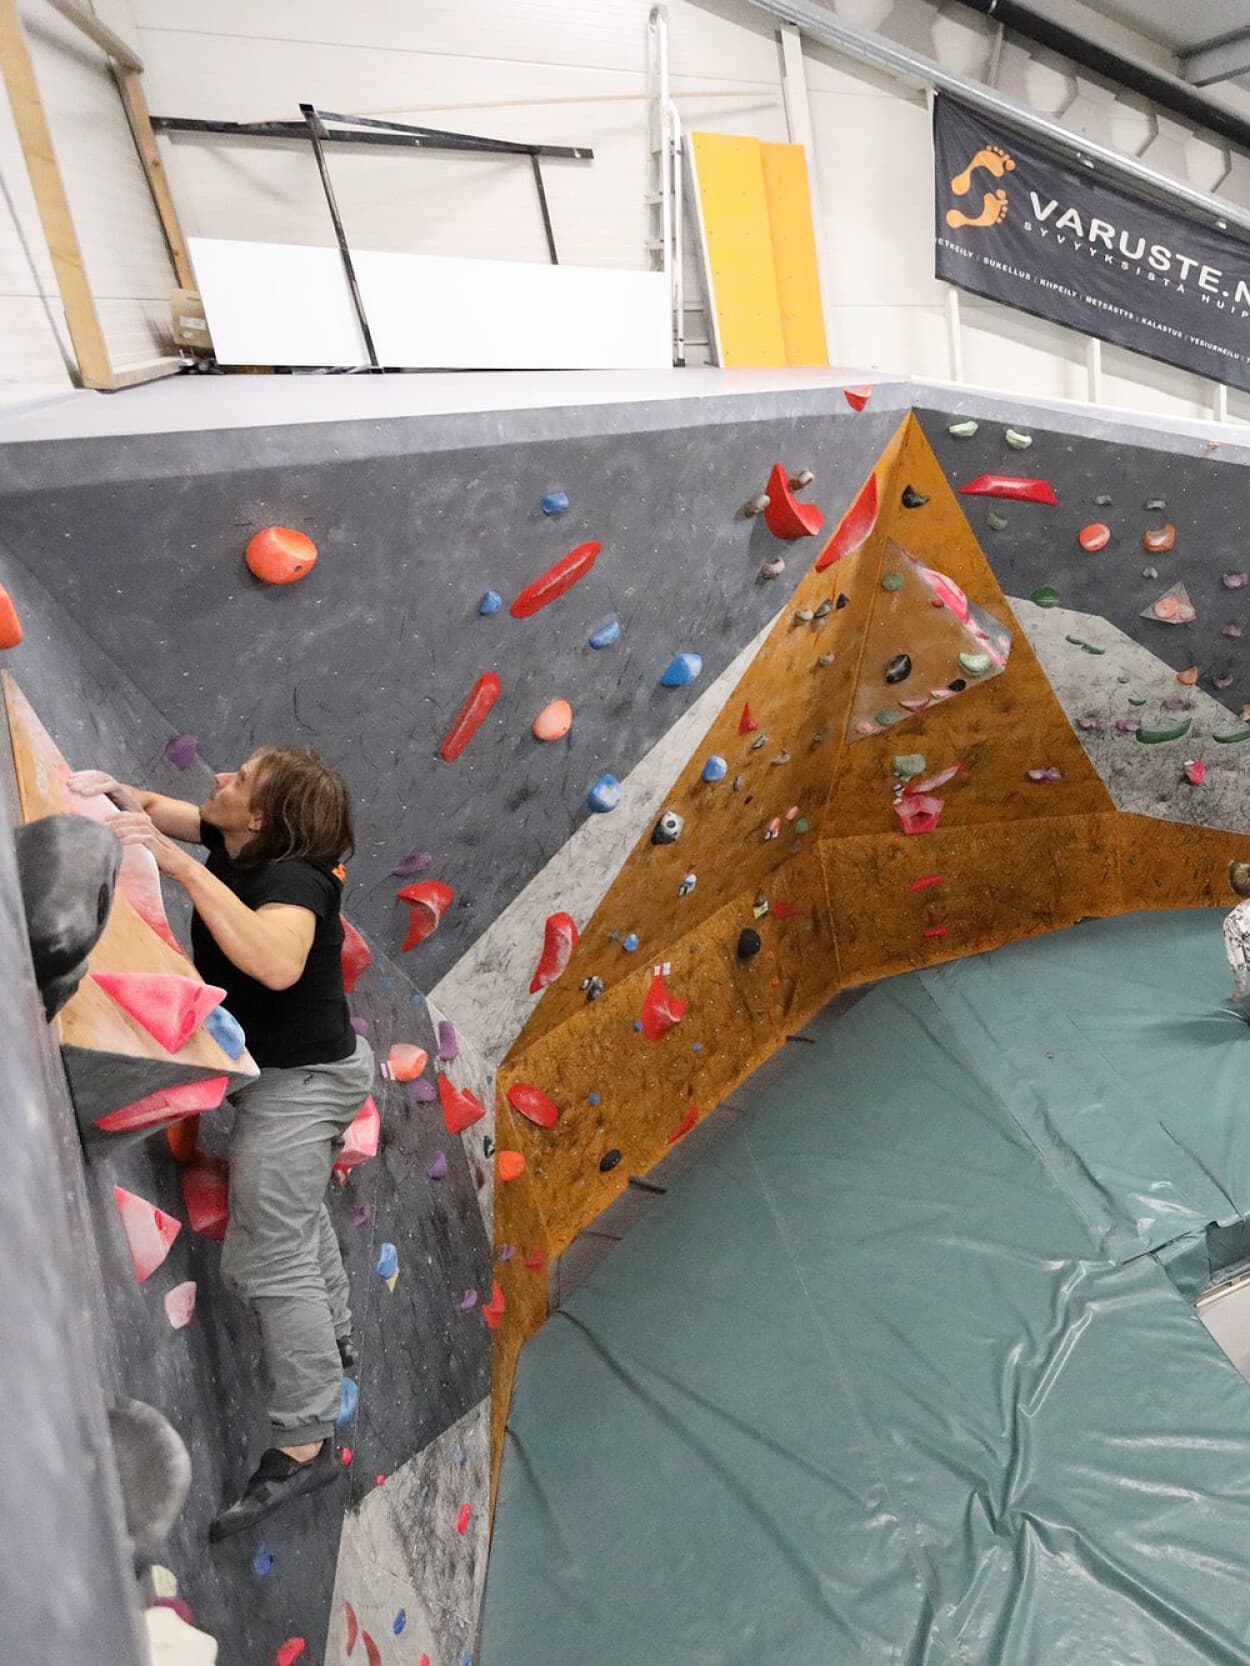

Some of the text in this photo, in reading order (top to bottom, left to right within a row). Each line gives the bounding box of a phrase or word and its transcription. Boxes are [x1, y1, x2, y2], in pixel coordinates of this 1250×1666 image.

[934, 237, 974, 259] ETKEILY
[983, 256, 1032, 281] SUKELLUS
[1039, 278, 1078, 298] KIIPEILY
[1141, 318, 1183, 338] KALASTUS
[1190, 336, 1240, 360] VESIURHEILU
